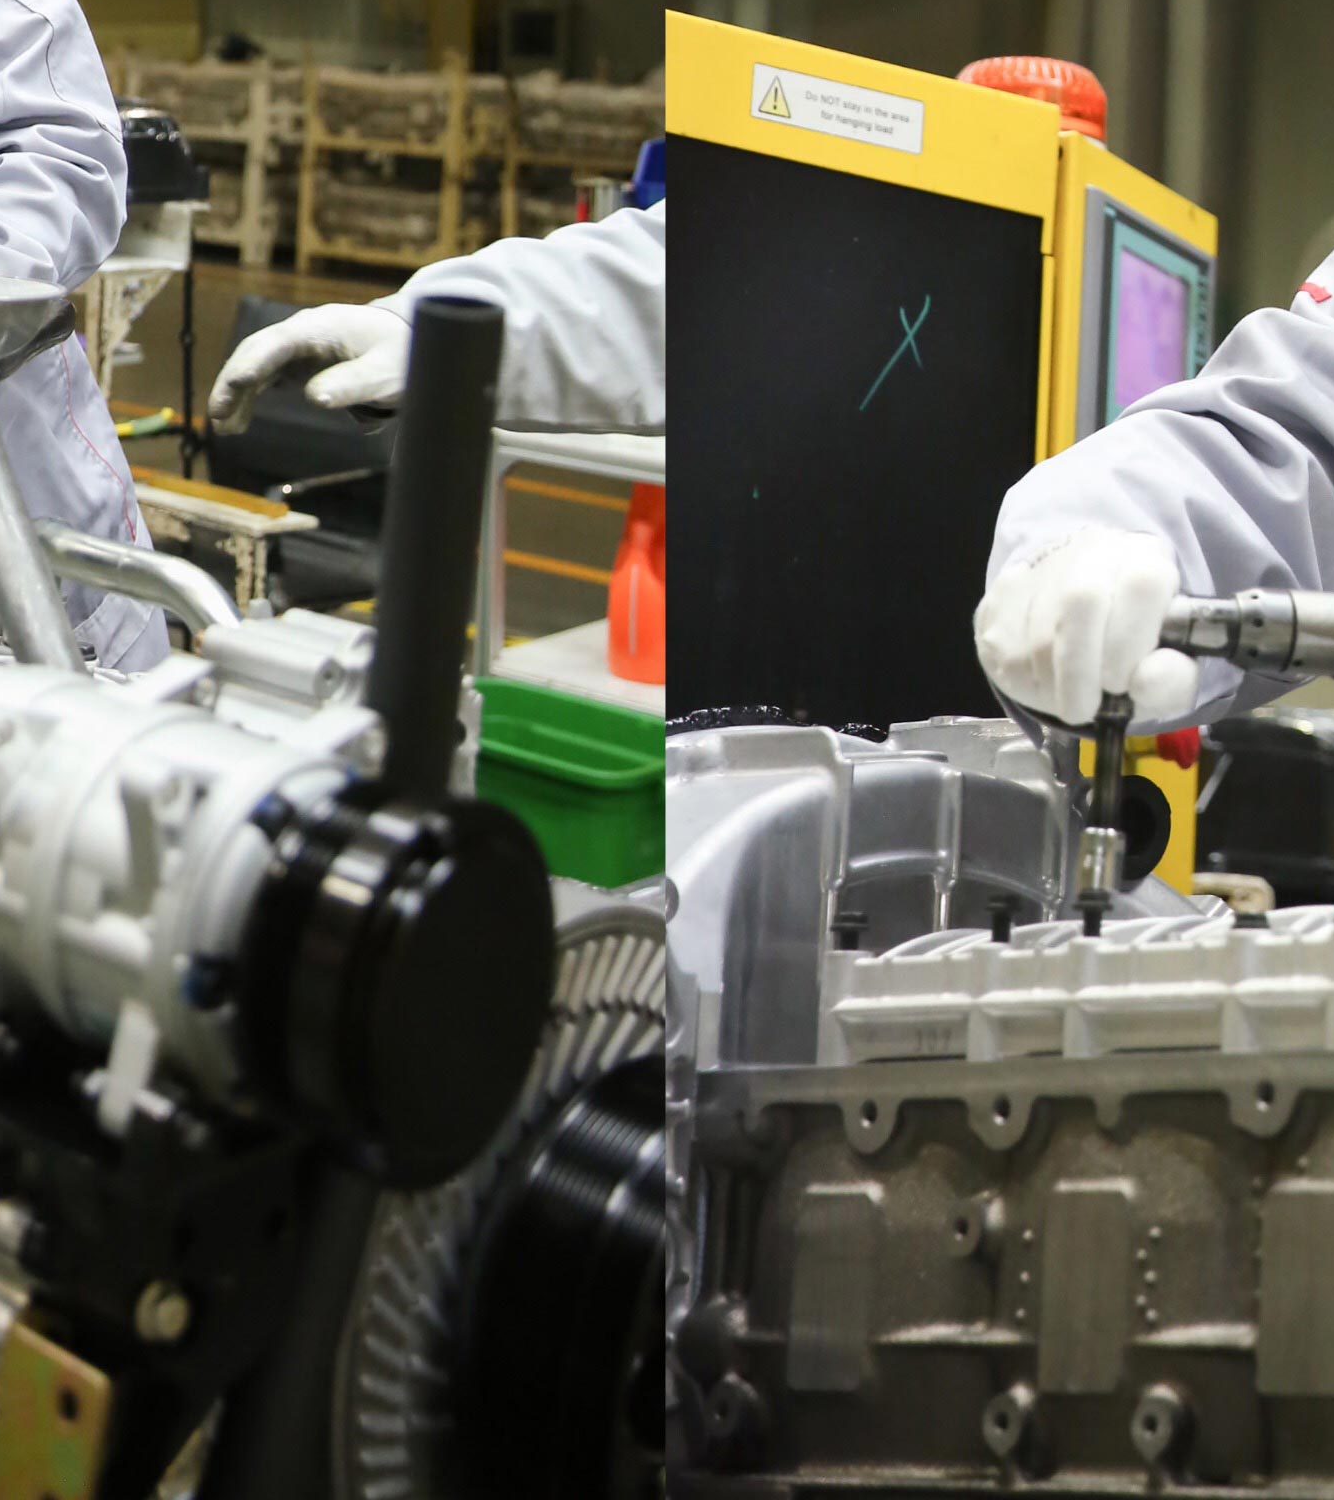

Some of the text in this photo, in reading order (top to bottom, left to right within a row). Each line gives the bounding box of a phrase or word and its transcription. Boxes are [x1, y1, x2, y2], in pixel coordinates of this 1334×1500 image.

[805, 90, 910, 123] Do NOT stay in the area
[821, 110, 894, 135] for hanging load
